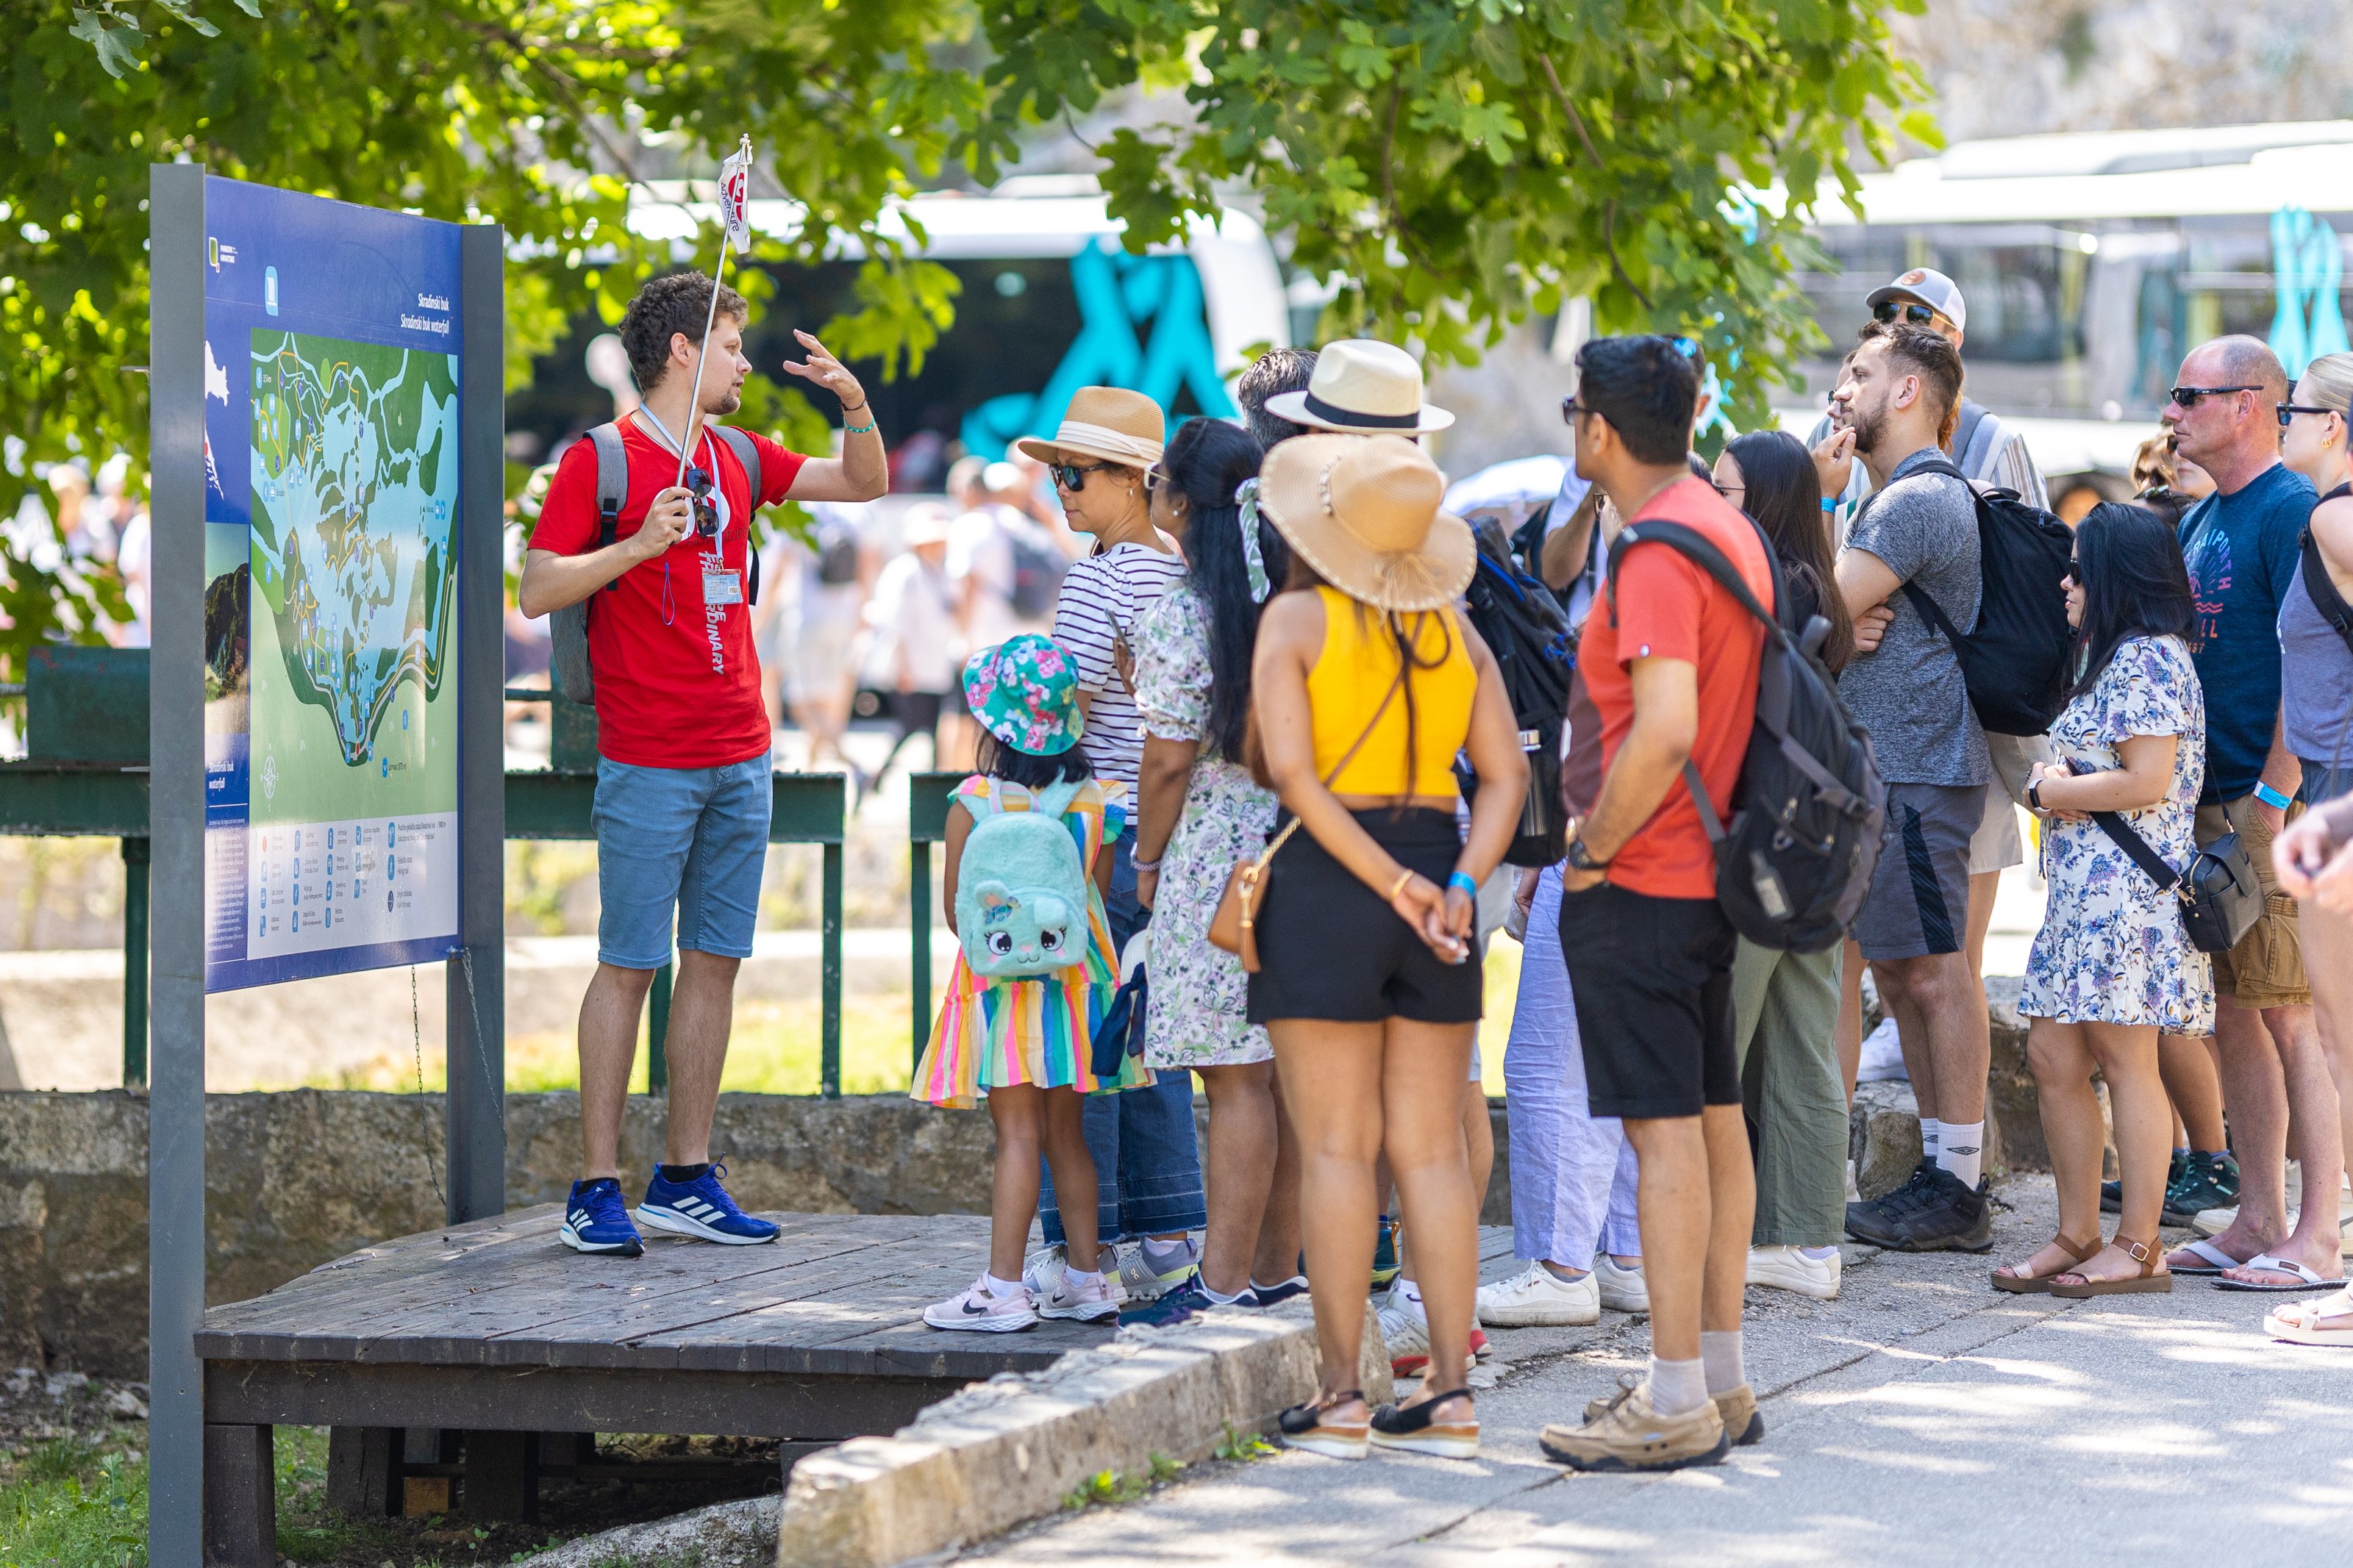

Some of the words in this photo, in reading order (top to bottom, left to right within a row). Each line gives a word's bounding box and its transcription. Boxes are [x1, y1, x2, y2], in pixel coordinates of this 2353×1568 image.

[418, 293, 440, 310] Skradinski
[440, 296, 449, 312] buk
[401, 313, 422, 330] Skradinski
[422, 315, 431, 332] buk
[431, 318, 450, 337] waterfall
[226, 760, 235, 772] buk
